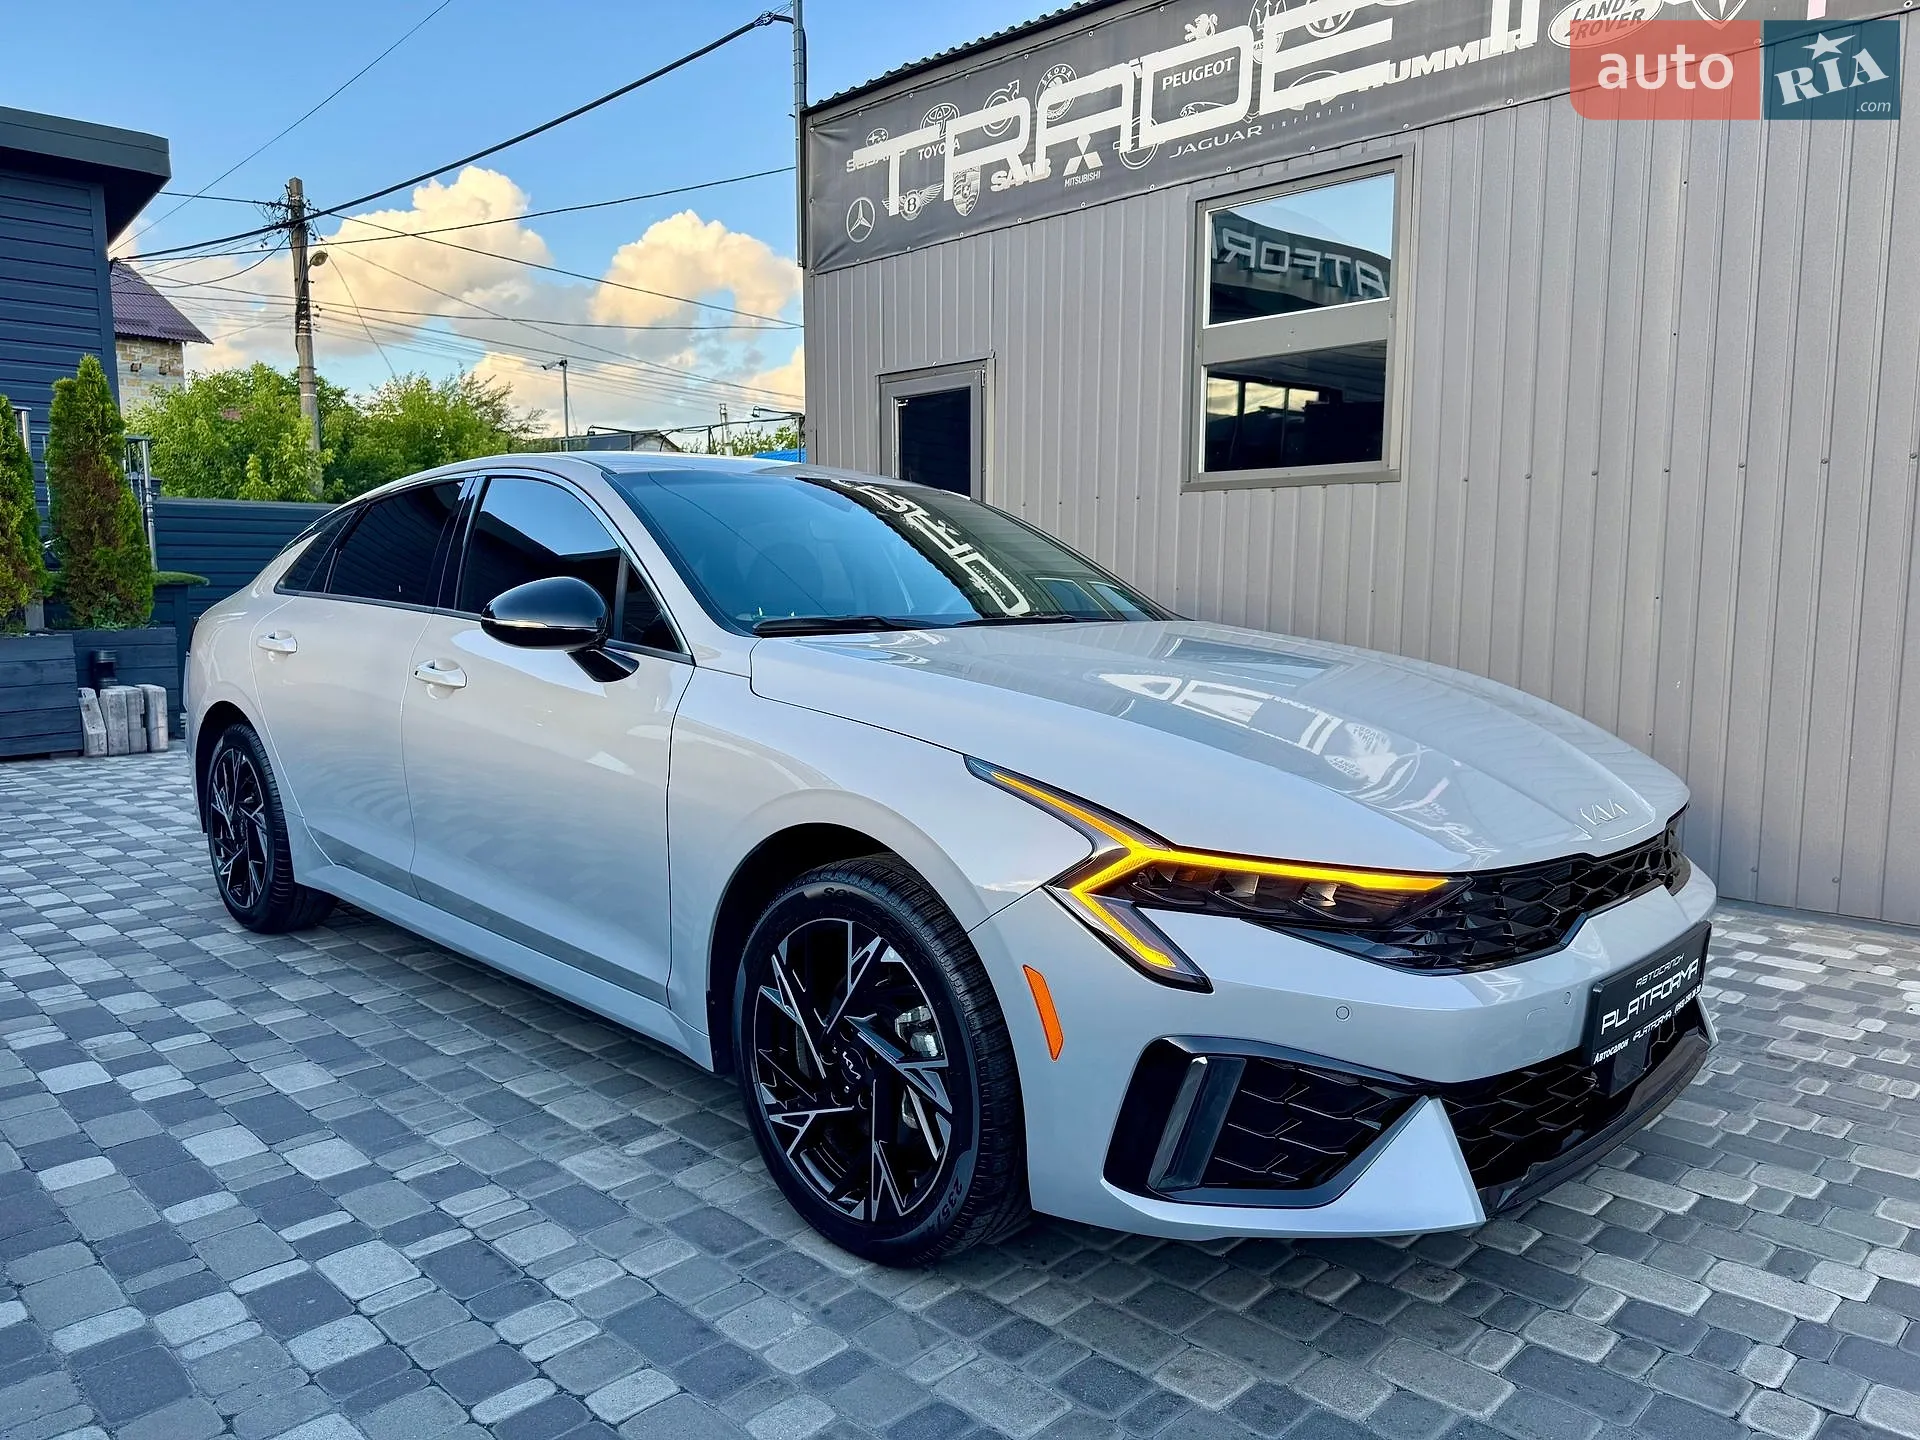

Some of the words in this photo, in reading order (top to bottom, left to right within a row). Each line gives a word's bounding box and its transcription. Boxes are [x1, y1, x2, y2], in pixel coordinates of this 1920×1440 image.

[1574, 8, 1645, 40] ROVER
[1162, 56, 1235, 90] PEUGEOT
[1271, 103, 1356, 130] INFINITI
[918, 138, 960, 161] TOYOA
[1169, 125, 1264, 158] JAGUAR
[1064, 171, 1101, 188] MITSUBISHI
[1601, 957, 1700, 1035] PLATFORMA
